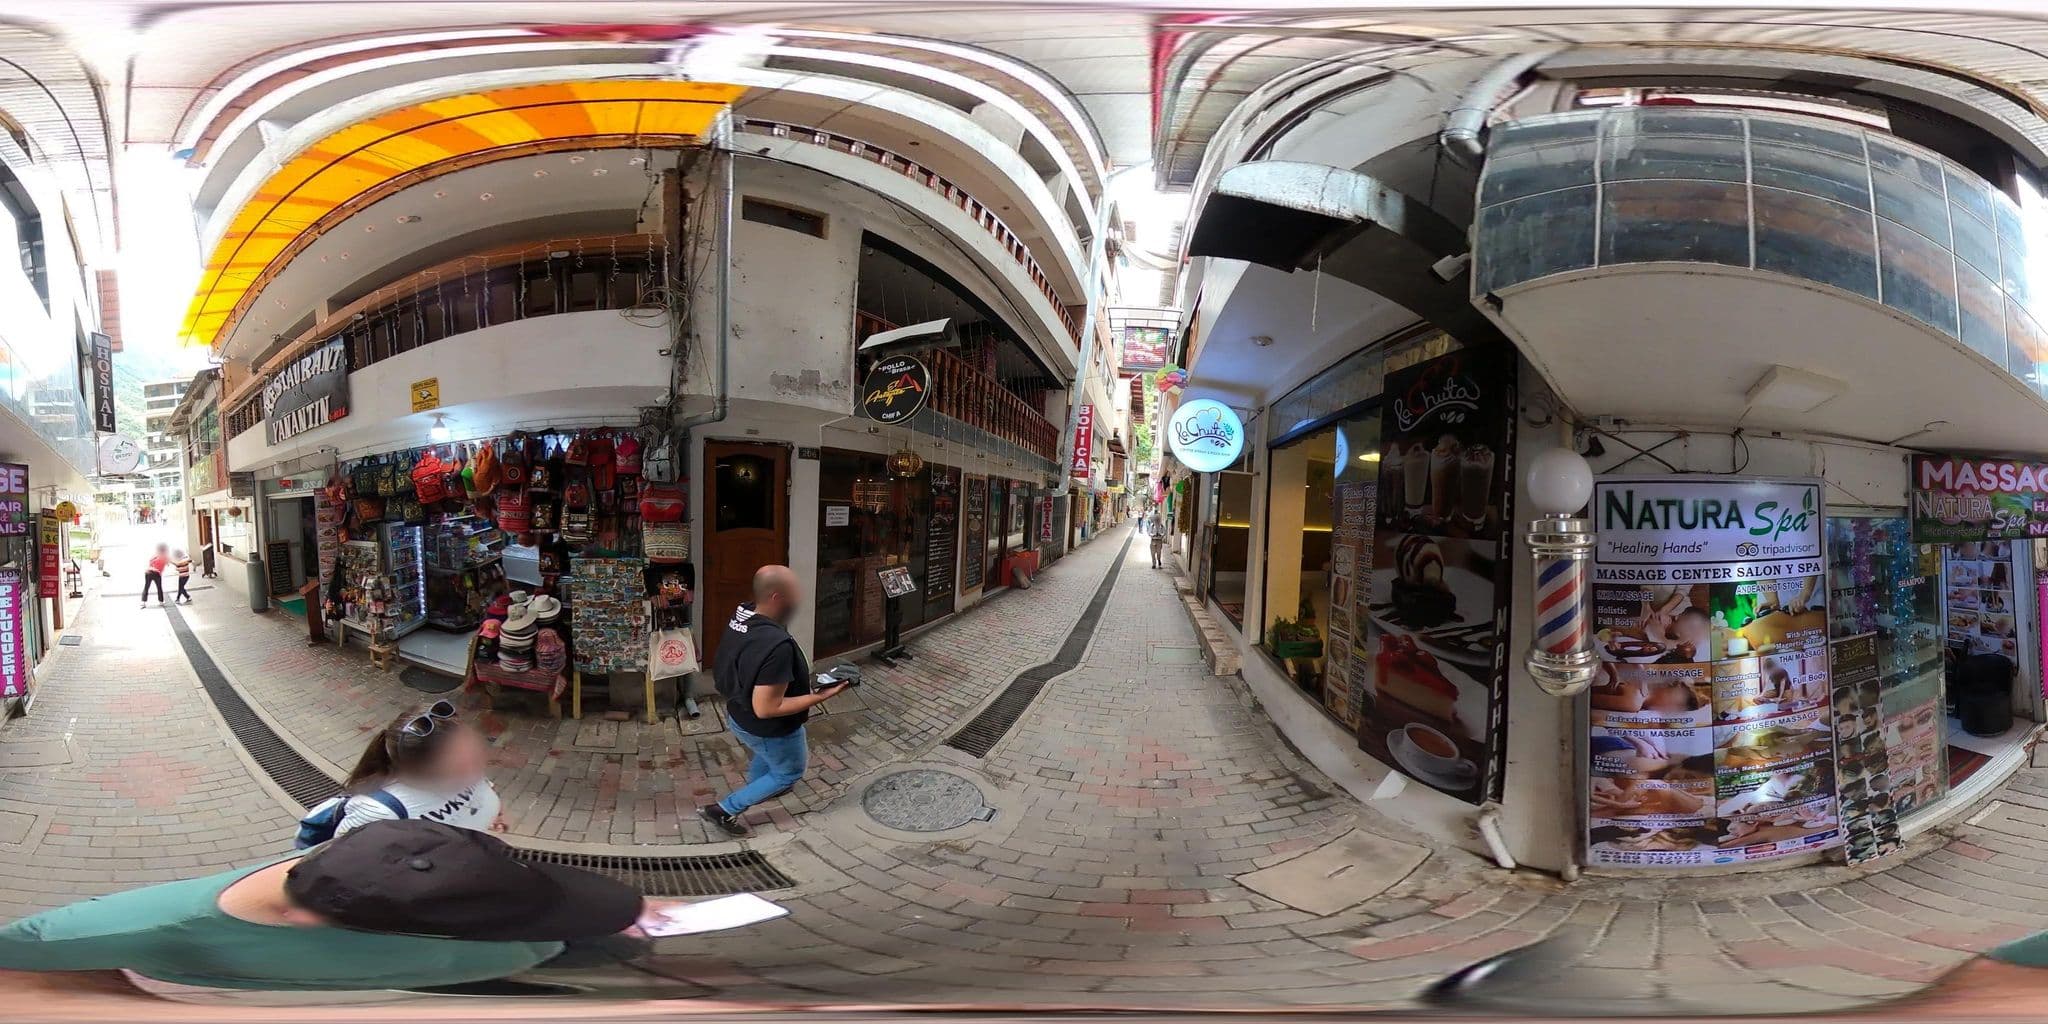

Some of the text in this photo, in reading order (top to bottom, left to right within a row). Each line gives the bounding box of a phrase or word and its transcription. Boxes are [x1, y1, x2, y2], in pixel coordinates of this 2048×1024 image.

[882, 361, 905, 371] POLLO
[96, 346, 112, 428] HOSTAL
[263, 344, 345, 417] RESTAURANT
[881, 410, 901, 419] CHIFA
[1074, 405, 1090, 468] BOTICA
[1605, 490, 1810, 541] NATURA Spa
[1914, 491, 2028, 533] NATURA Spa
[1596, 568, 1667, 580] MASSAGE
[1671, 567, 1732, 580] CENTER
[1736, 565, 1782, 578] SALON
[1785, 563, 1795, 574] Y
[1797, 562, 1821, 573] SPA
[1735, 580, 1804, 595] ANDEAN HOT STONE
[1897, 576, 1926, 588] SHAMPOO
[1615, 590, 1655, 602] MASSAGE
[1597, 605, 1628, 615] Holistic
[1597, 616, 1634, 628] Full Body
[0, 584, 18, 696] PELUQUERIA
[1779, 649, 1825, 663] THAI MASSAGE
[1660, 668, 1703, 678] MASSAGE
[1792, 676, 1807, 685] Full
[1808, 671, 1827, 682] Body
[1732, 710, 1820, 732] FOCUSED MASSAGE
[1607, 729, 1695, 738] SHIATSU MASSAGE
